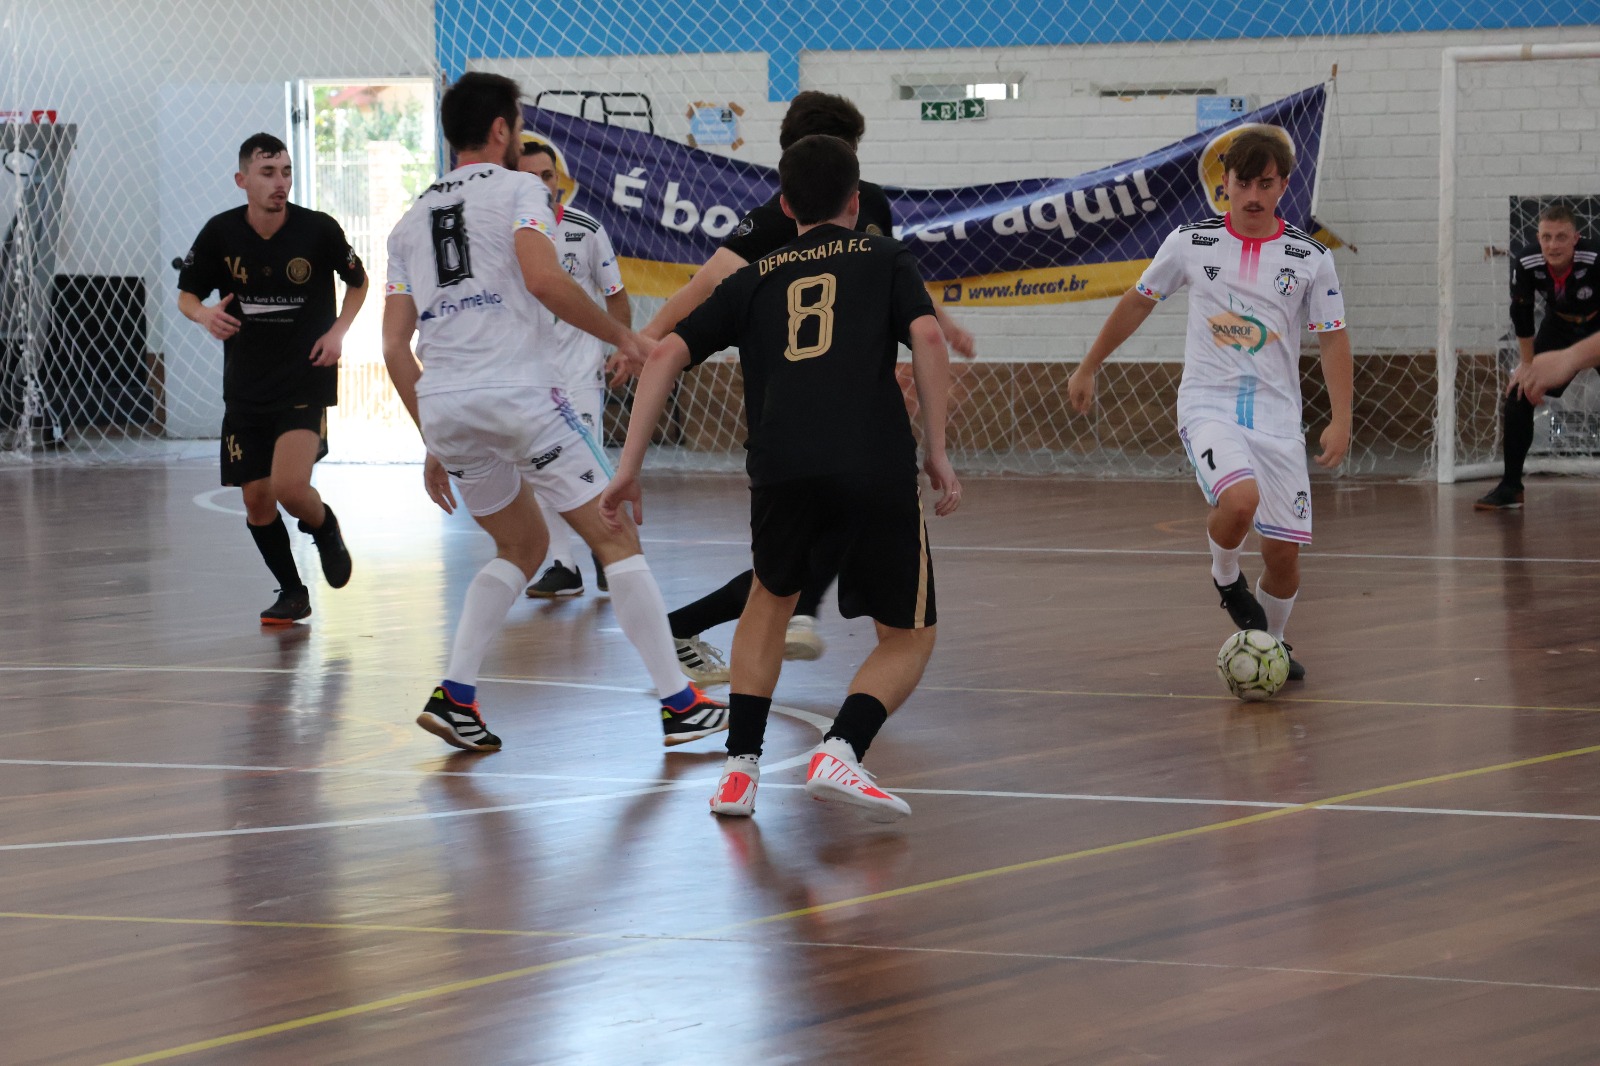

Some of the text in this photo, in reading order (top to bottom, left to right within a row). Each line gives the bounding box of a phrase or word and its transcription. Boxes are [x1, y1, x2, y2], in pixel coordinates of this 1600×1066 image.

[612, 167, 647, 212] É
[661, 182, 750, 238] bo
[992, 169, 1157, 239] aqui!
[429, 199, 474, 288] 8
[564, 231, 586, 239] Group
[1191, 233, 1220, 244] Group
[758, 238, 872, 276] DEMOCRATA F.C.
[1284, 244, 1311, 257] Group
[224, 256, 248, 284] 14
[968, 274, 1089, 299] www.faccat.br
[783, 272, 837, 361] 8
[1201, 448, 1216, 471] 7
[810, 754, 869, 792] NIKE
